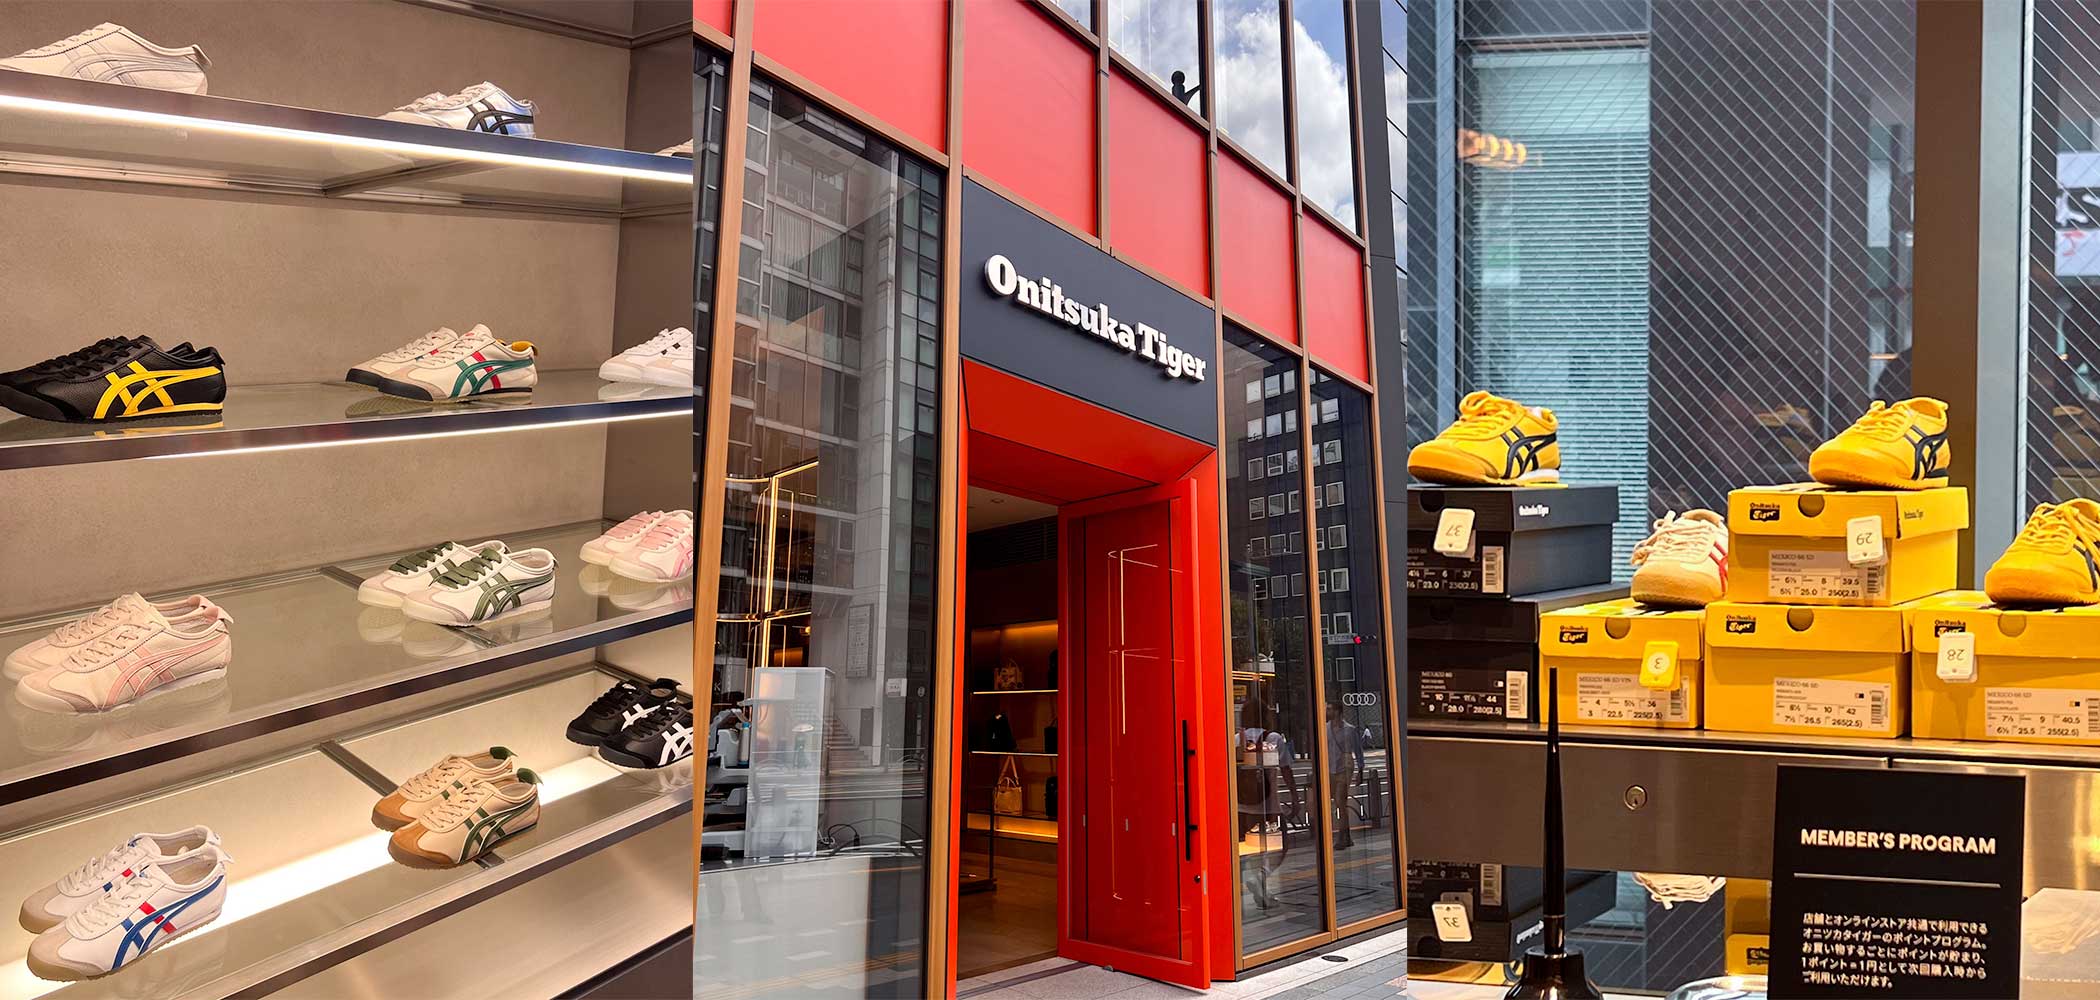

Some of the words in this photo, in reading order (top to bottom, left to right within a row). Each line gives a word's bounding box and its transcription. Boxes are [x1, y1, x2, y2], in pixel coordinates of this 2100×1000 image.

[985, 254, 1136, 352] Onitsuka
[1136, 322, 1206, 380] Tiger
[1801, 828, 1895, 849] MEMBER'S
[1899, 833, 1996, 854] PROGRAM
[1803, 912, 1988, 934] 店舗とオンラインストア共通で利用できる
[1803, 927, 1987, 950] オニツカタイガーのポイントプログラム。
[1802, 942, 1986, 965] お買い物するごとにポイントが貯まり、
[1802, 971, 1893, 988] ご利用いただけます。
